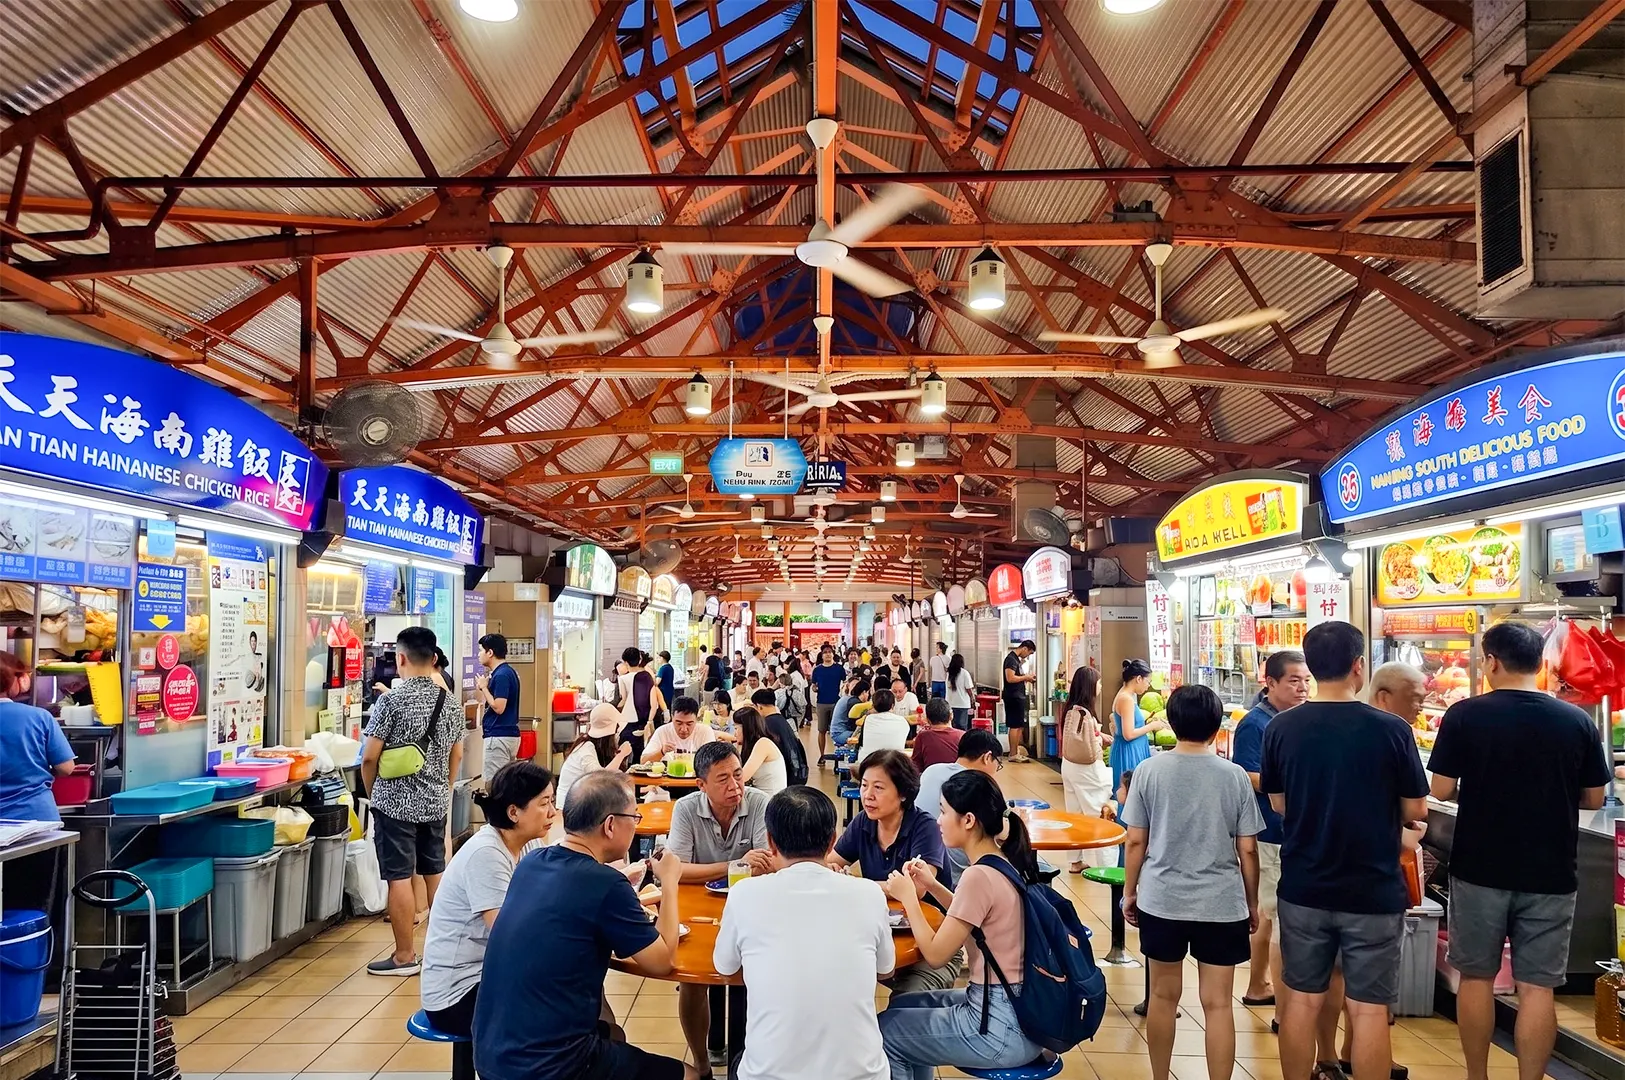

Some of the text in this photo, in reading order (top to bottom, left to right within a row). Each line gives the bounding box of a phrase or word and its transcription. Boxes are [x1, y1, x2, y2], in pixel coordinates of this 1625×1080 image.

[28, 431, 78, 463] TIAN
[82, 445, 181, 486] HAINANESE
[184, 473, 241, 501] CHICKEN
[244, 487, 270, 508] RICE
[1415, 451, 1457, 477] SOUTH
[1459, 429, 1533, 465] DELICIOUS
[1537, 414, 1586, 444] FOOD
[347, 515, 367, 532] TIAN
[369, 520, 387, 537] TIAN
[350, 478, 461, 536] 天天海南雞飯
